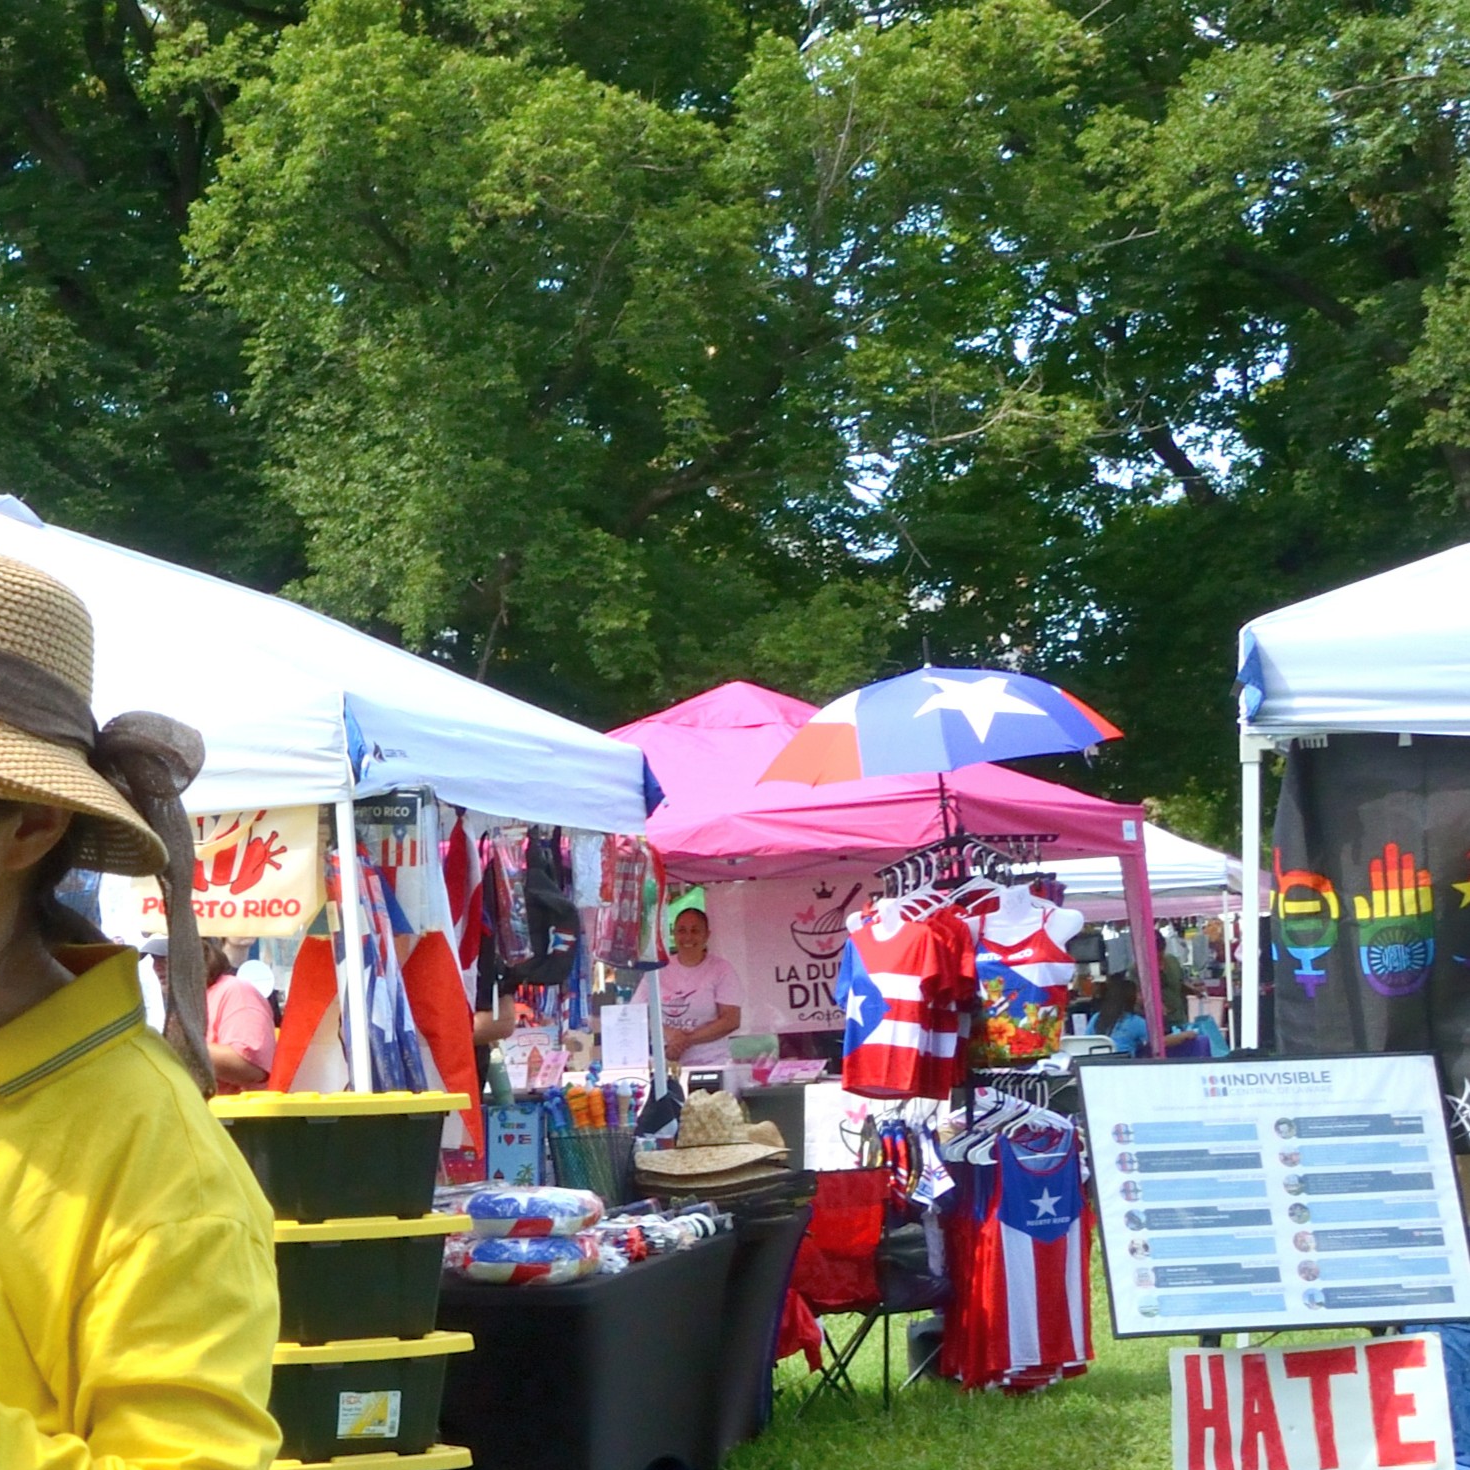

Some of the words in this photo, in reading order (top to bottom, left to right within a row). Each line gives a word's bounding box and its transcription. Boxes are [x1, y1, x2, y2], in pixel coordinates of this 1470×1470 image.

[384, 806, 410, 817] RICO
[142, 896, 237, 918] PRTO
[243, 898, 301, 918] RICO
[775, 965, 800, 982] LA
[807, 961, 842, 980] DU
[1228, 1070, 1332, 1086] INDIVISIBLE
